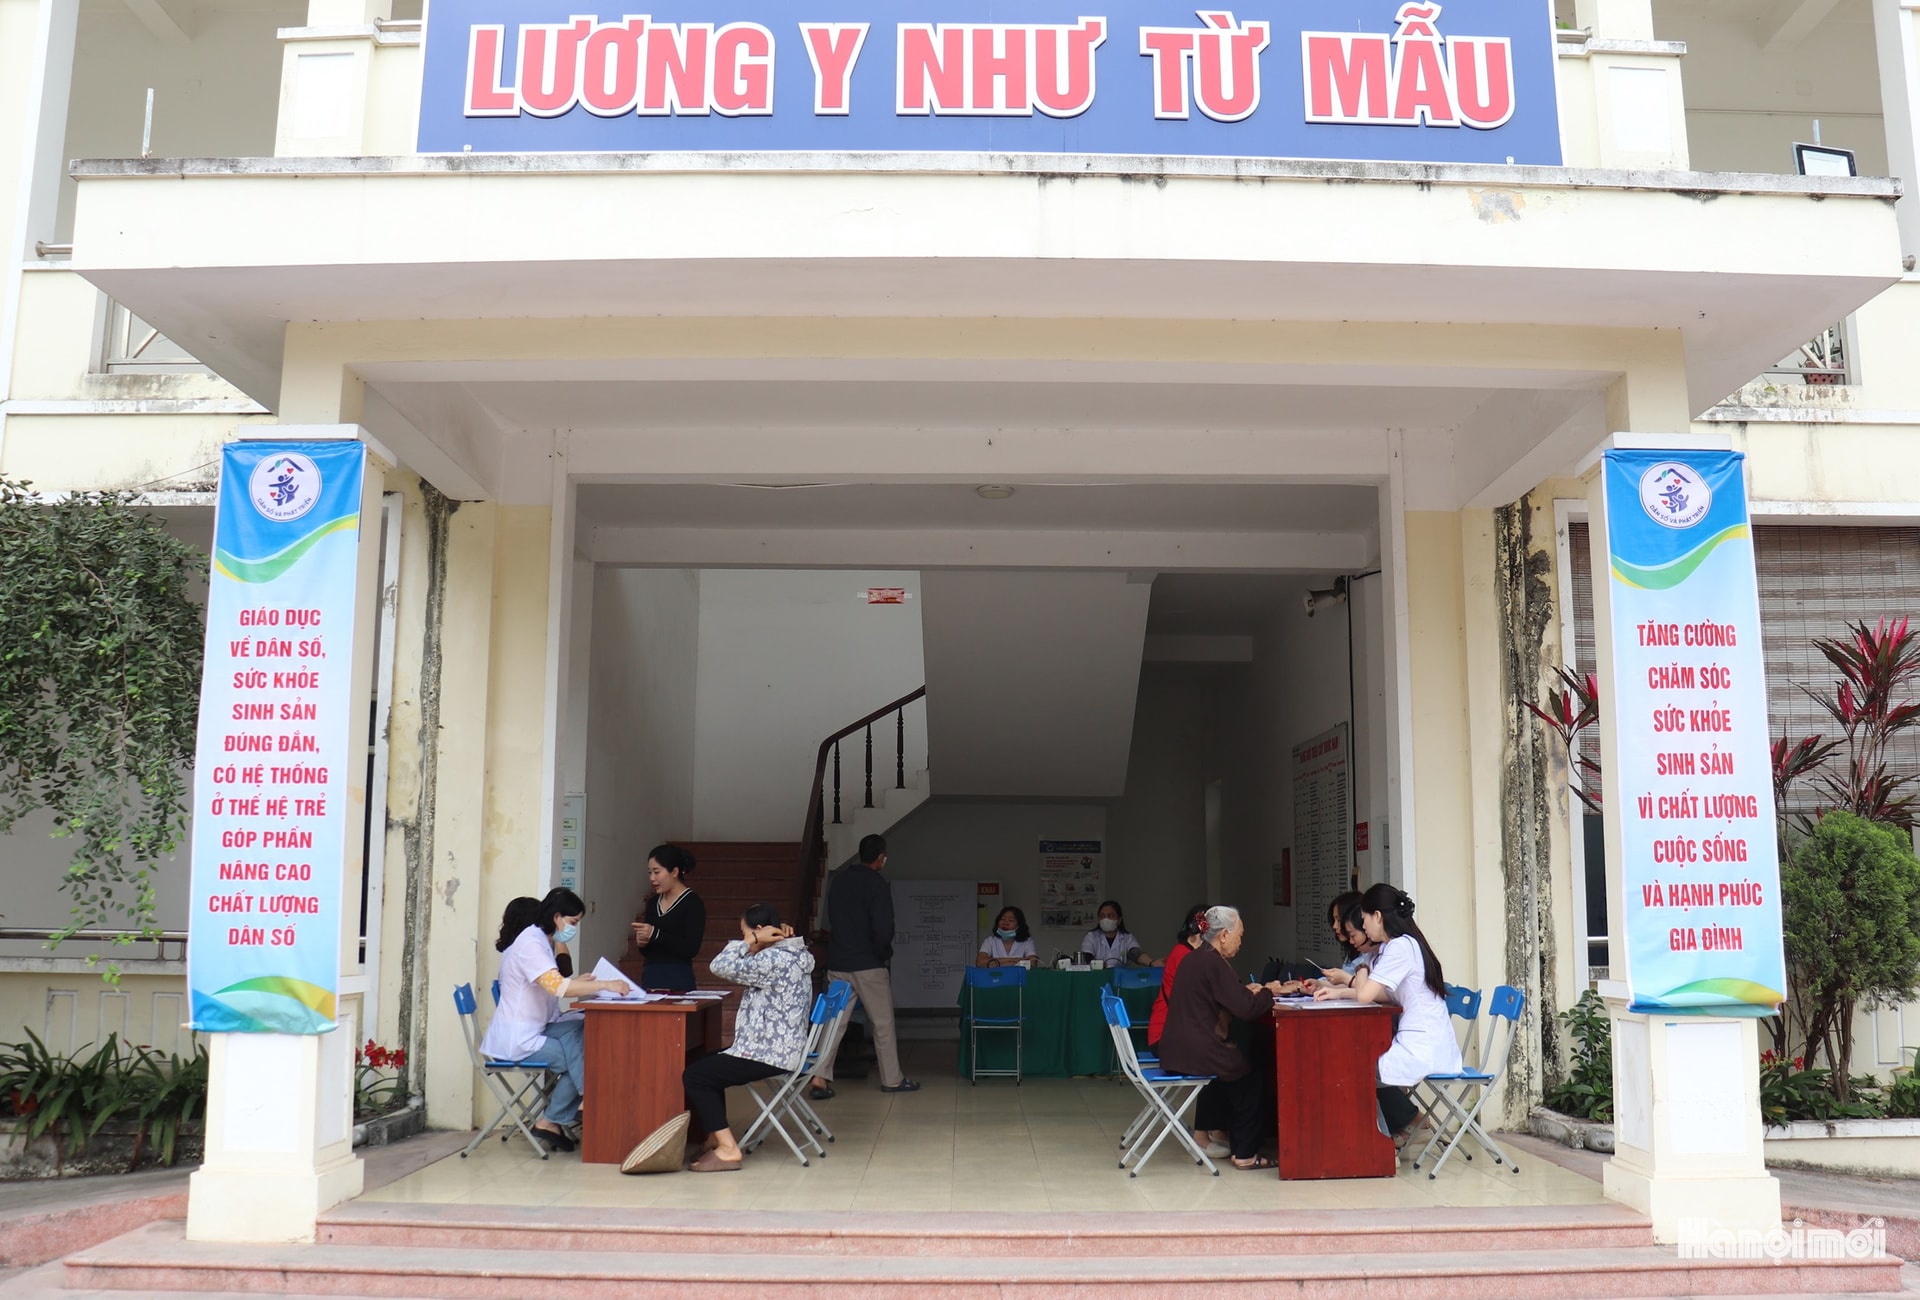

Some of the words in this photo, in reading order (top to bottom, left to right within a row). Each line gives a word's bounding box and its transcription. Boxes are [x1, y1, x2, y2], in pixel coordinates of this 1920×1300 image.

[464, 14, 775, 118] LƯƠNG
[798, 23, 870, 116] Y
[896, 16, 1108, 118] NHƯ
[1140, 10, 1270, 122] TỪ
[1301, 0, 1516, 129] MẪU
[240, 606, 279, 626] GIÁO
[285, 609, 321, 629] DỤC
[1637, 619, 1679, 646] TĂNG
[1684, 618, 1736, 647] CƯỜNG
[230, 635, 250, 657] VỀ
[256, 638, 292, 657] DÂN
[298, 635, 326, 659] SỐ,
[233, 667, 267, 689] SỨC
[274, 665, 319, 689] KHỎE
[1649, 662, 1695, 689] CHĂM
[1700, 662, 1731, 689] SÓC
[232, 703, 274, 720] SINH
[280, 697, 316, 720] SẢN
[1653, 703, 1685, 732] SỨC
[1690, 700, 1732, 732] KHỎE
[224, 732, 272, 752] ĐÚNG
[278, 730, 320, 754] ĐẮN,
[1657, 752, 1695, 776] SINH
[1700, 743, 1733, 775] SẢN
[213, 763, 236, 784] CÓ
[242, 764, 264, 787] HỆ
[271, 762, 328, 784] THỐNG
[211, 792, 224, 816] Ở
[229, 793, 261, 816] THẾ
[266, 796, 288, 819] HỆ
[295, 792, 326, 816] TRẺ
[1638, 792, 1653, 819] VÌ
[1658, 788, 1698, 819] CHẤT
[1704, 793, 1758, 823] LƯỢNG
[222, 828, 257, 848] GÓP
[263, 825, 312, 848] PHẦN
[1654, 835, 1697, 868] CUỘC
[1702, 831, 1747, 862] SỐNG
[220, 860, 269, 880] NÂNG
[275, 863, 311, 881] CAO
[209, 890, 254, 913] CHẤT
[259, 895, 319, 917] LƯỢNG
[1642, 879, 1664, 907] VÀ
[1669, 884, 1713, 912] HẠNH
[1719, 878, 1763, 906] PHÚC
[228, 925, 264, 945] DÂN
[271, 923, 296, 946] SỐ
[1670, 928, 1697, 951] GIA
[1702, 922, 1742, 951] ĐÌNH
